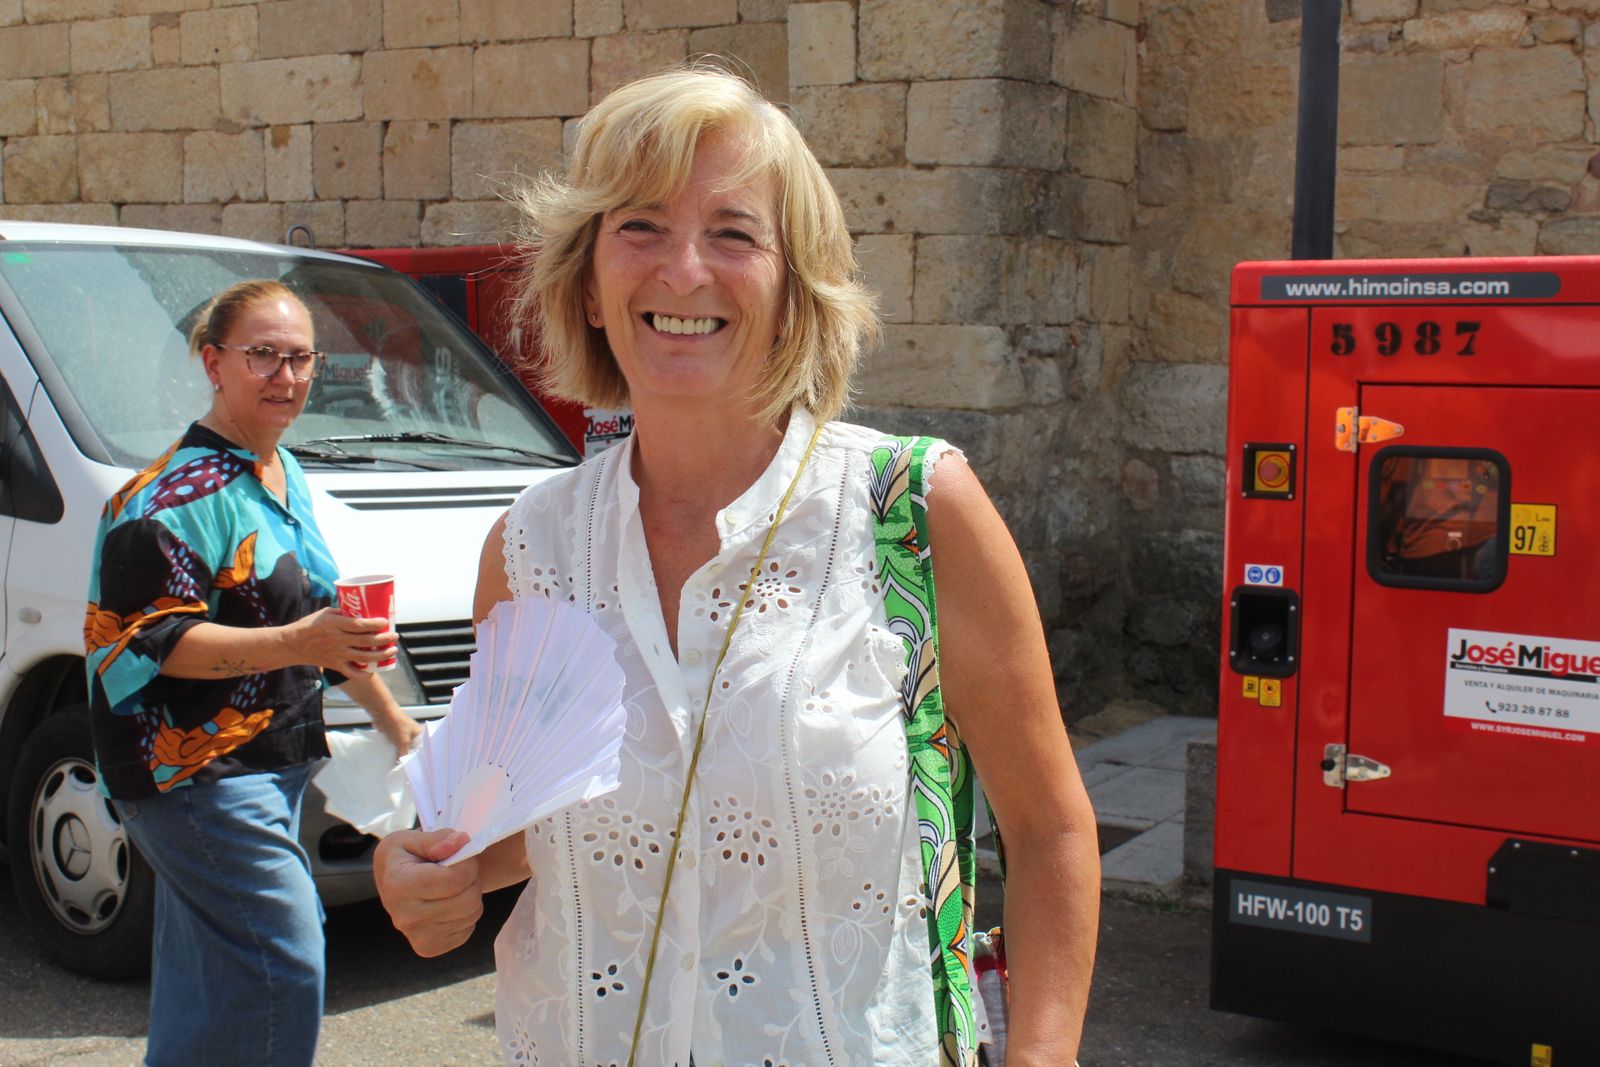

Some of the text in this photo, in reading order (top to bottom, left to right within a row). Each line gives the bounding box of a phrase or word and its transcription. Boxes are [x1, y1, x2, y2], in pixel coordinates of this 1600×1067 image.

[1285, 278, 1509, 296] www.himoinsa.com
[1330, 320, 1481, 356] 5987
[1514, 525, 1536, 551] 97
[1451, 639, 1515, 665] José
[1464, 680, 1488, 688] VENTA
[1496, 683, 1534, 693] ALQUILER
[1536, 687, 1545, 695] DE
[1548, 689, 1599, 700] MAQUINARIA
[1498, 703, 1570, 718] 923 28 87 88
[1238, 893, 1363, 932] HFW-100 T5
